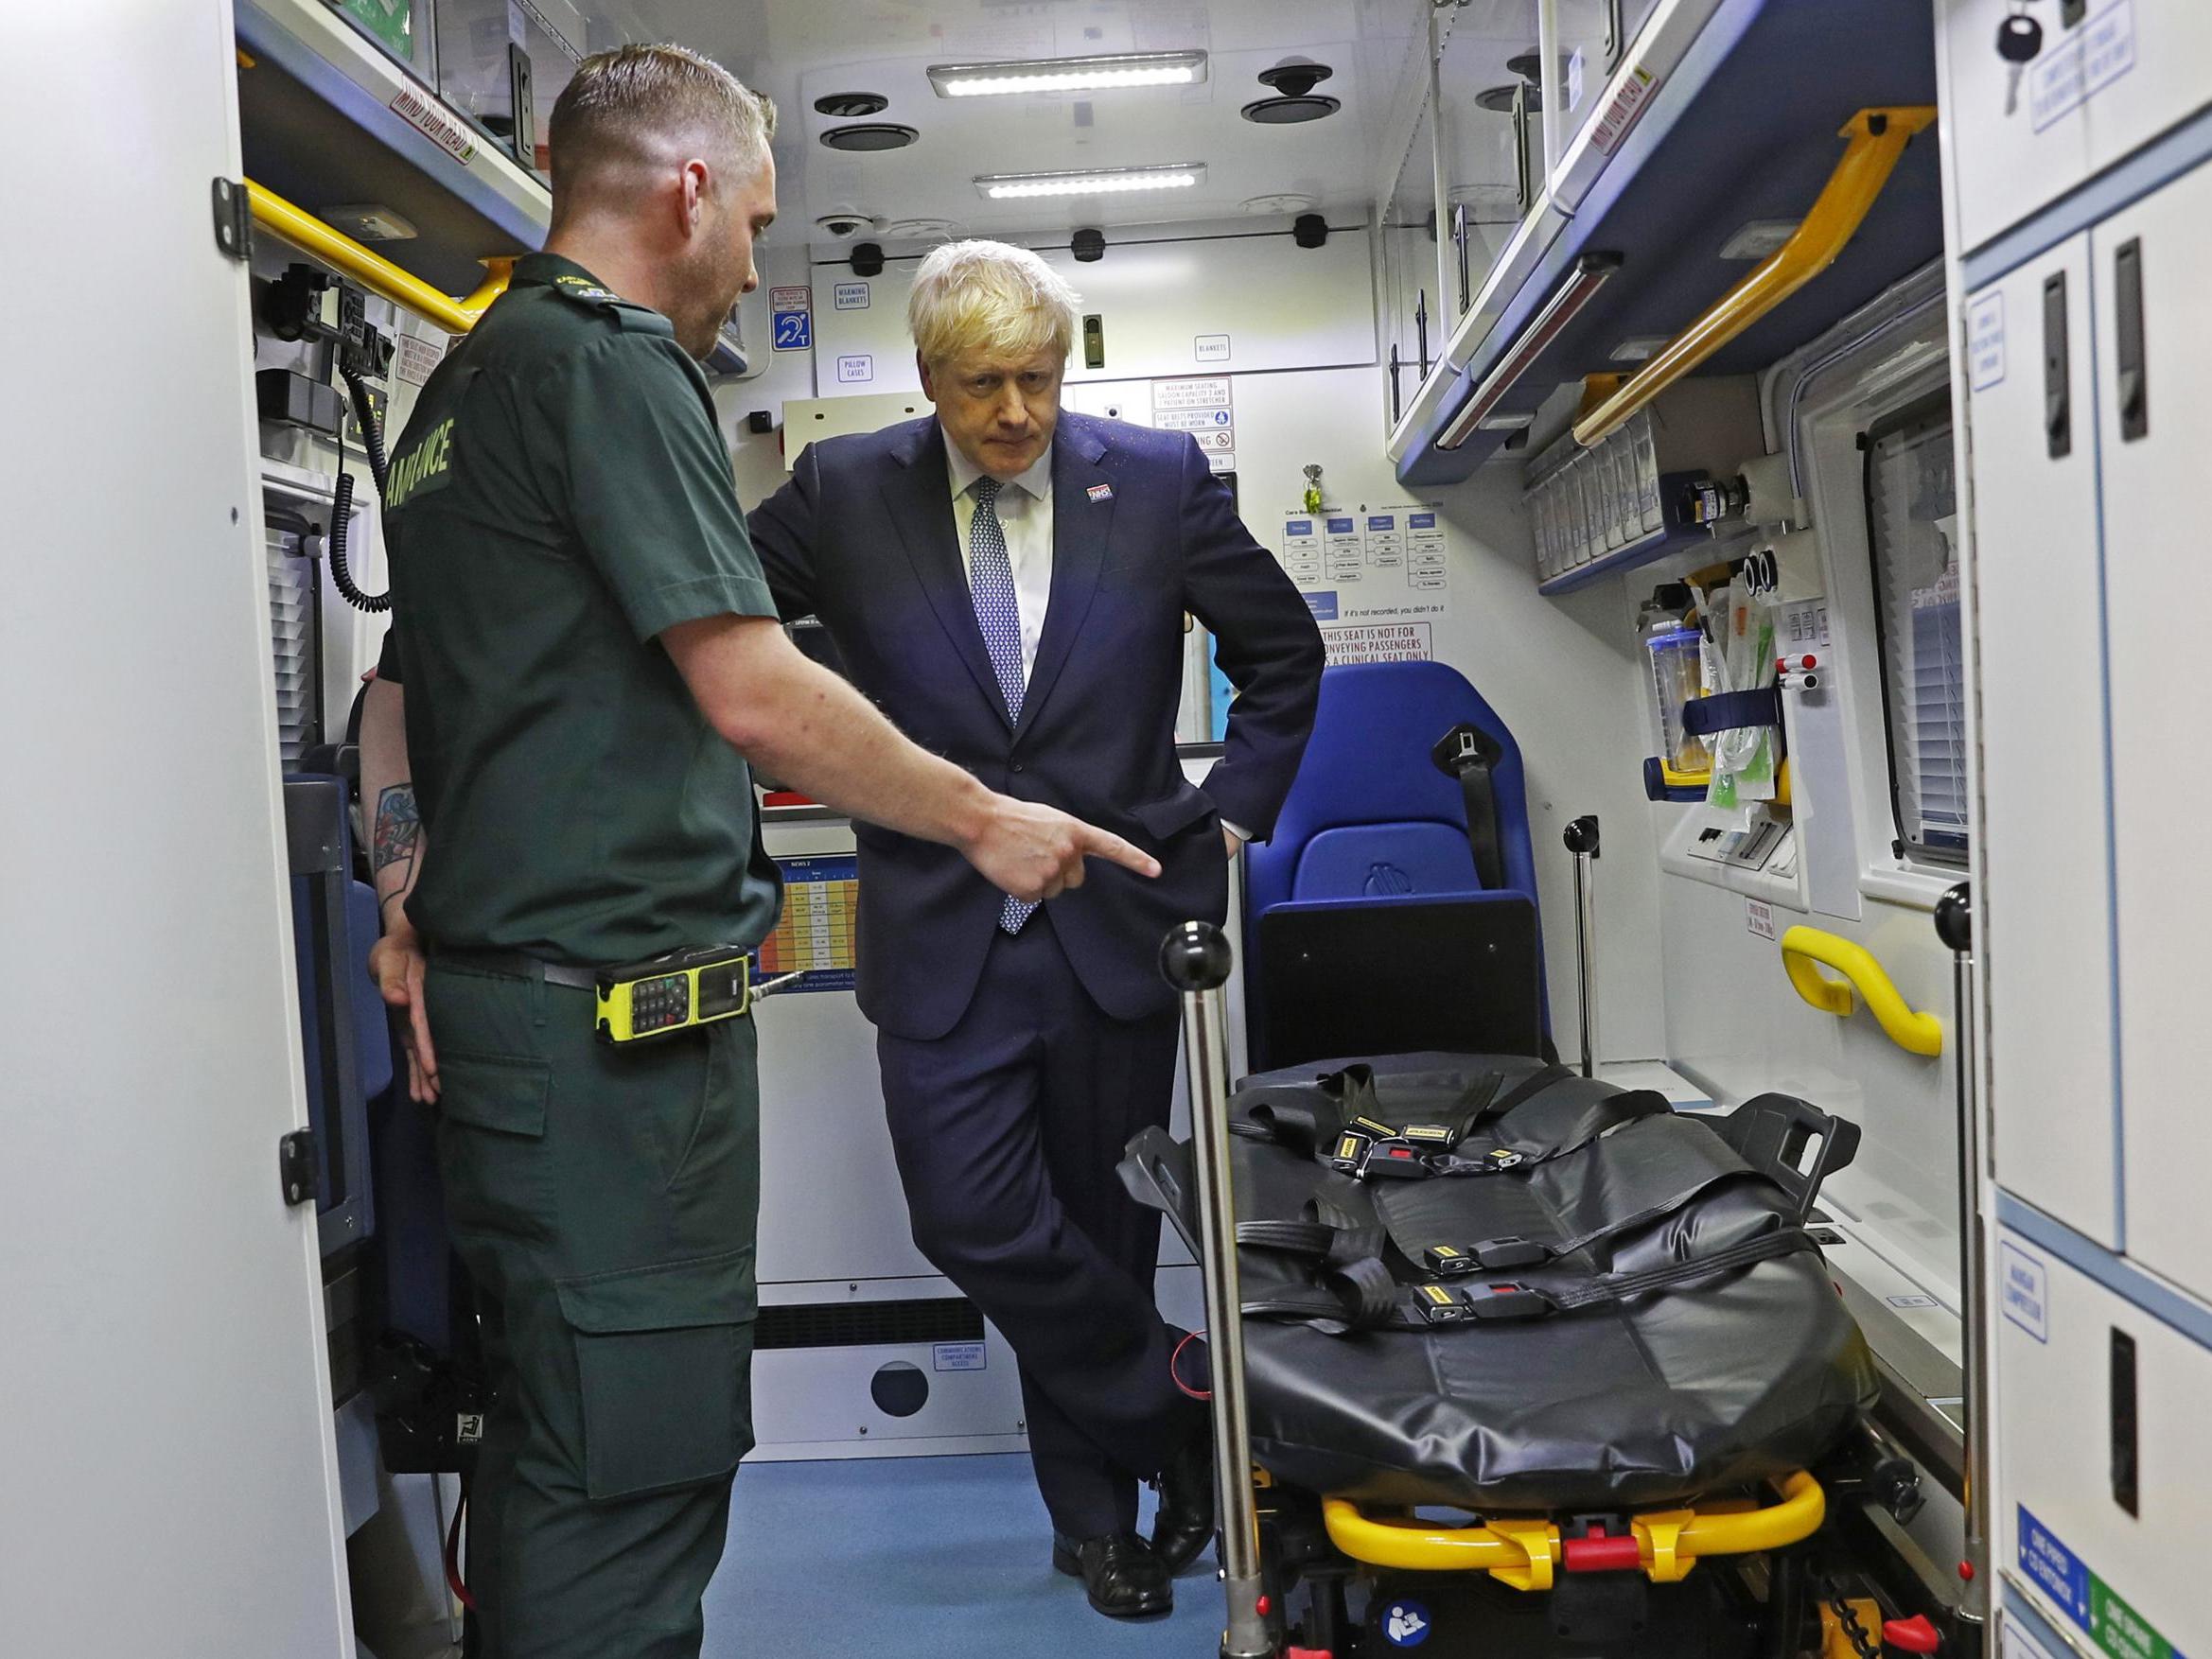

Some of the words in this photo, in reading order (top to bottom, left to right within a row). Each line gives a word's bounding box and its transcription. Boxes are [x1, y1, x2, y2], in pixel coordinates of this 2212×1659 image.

[1590, 121, 1613, 149] MIND
[1604, 99, 1628, 129] YOUR
[1617, 77, 1642, 108] HEAD
[838, 287, 867, 296] WARMING
[838, 295, 868, 305] BLANKETS
[1199, 343, 1227, 353] BLANKETS
[844, 359, 866, 369] PILLOW
[847, 368, 865, 377] CASES
[1166, 383, 1194, 392] MAXIMUM
[1194, 381, 1219, 390] SEATING
[1157, 391, 1181, 399] SALOON
[1181, 390, 1207, 398] CAPACITY
[1164, 398, 1186, 407] PATIENT
[1196, 395, 1226, 404] STRETCHER
[1156, 413, 1171, 422] SEAT
[1171, 412, 1187, 421] BELTS
[1187, 410, 1215, 419] PROVIDED
[1091, 487, 1109, 499] NHS
[1400, 607, 1413, 616] you
[1413, 605, 1430, 615] didn't
[1431, 604, 1439, 613] do
[1323, 630, 1342, 641] THIS
[1344, 629, 1365, 641] SEAT
[1367, 629, 1376, 639] IS
[1378, 627, 1396, 638] NOT
[1397, 626, 1415, 637] FOR
[1369, 638, 1422, 652] PASSENGERS
[1333, 656, 1340, 665] A
[1342, 653, 1379, 665] CLINICAL
[1383, 652, 1403, 663] SEAT
[1406, 651, 1430, 662] ONLY
